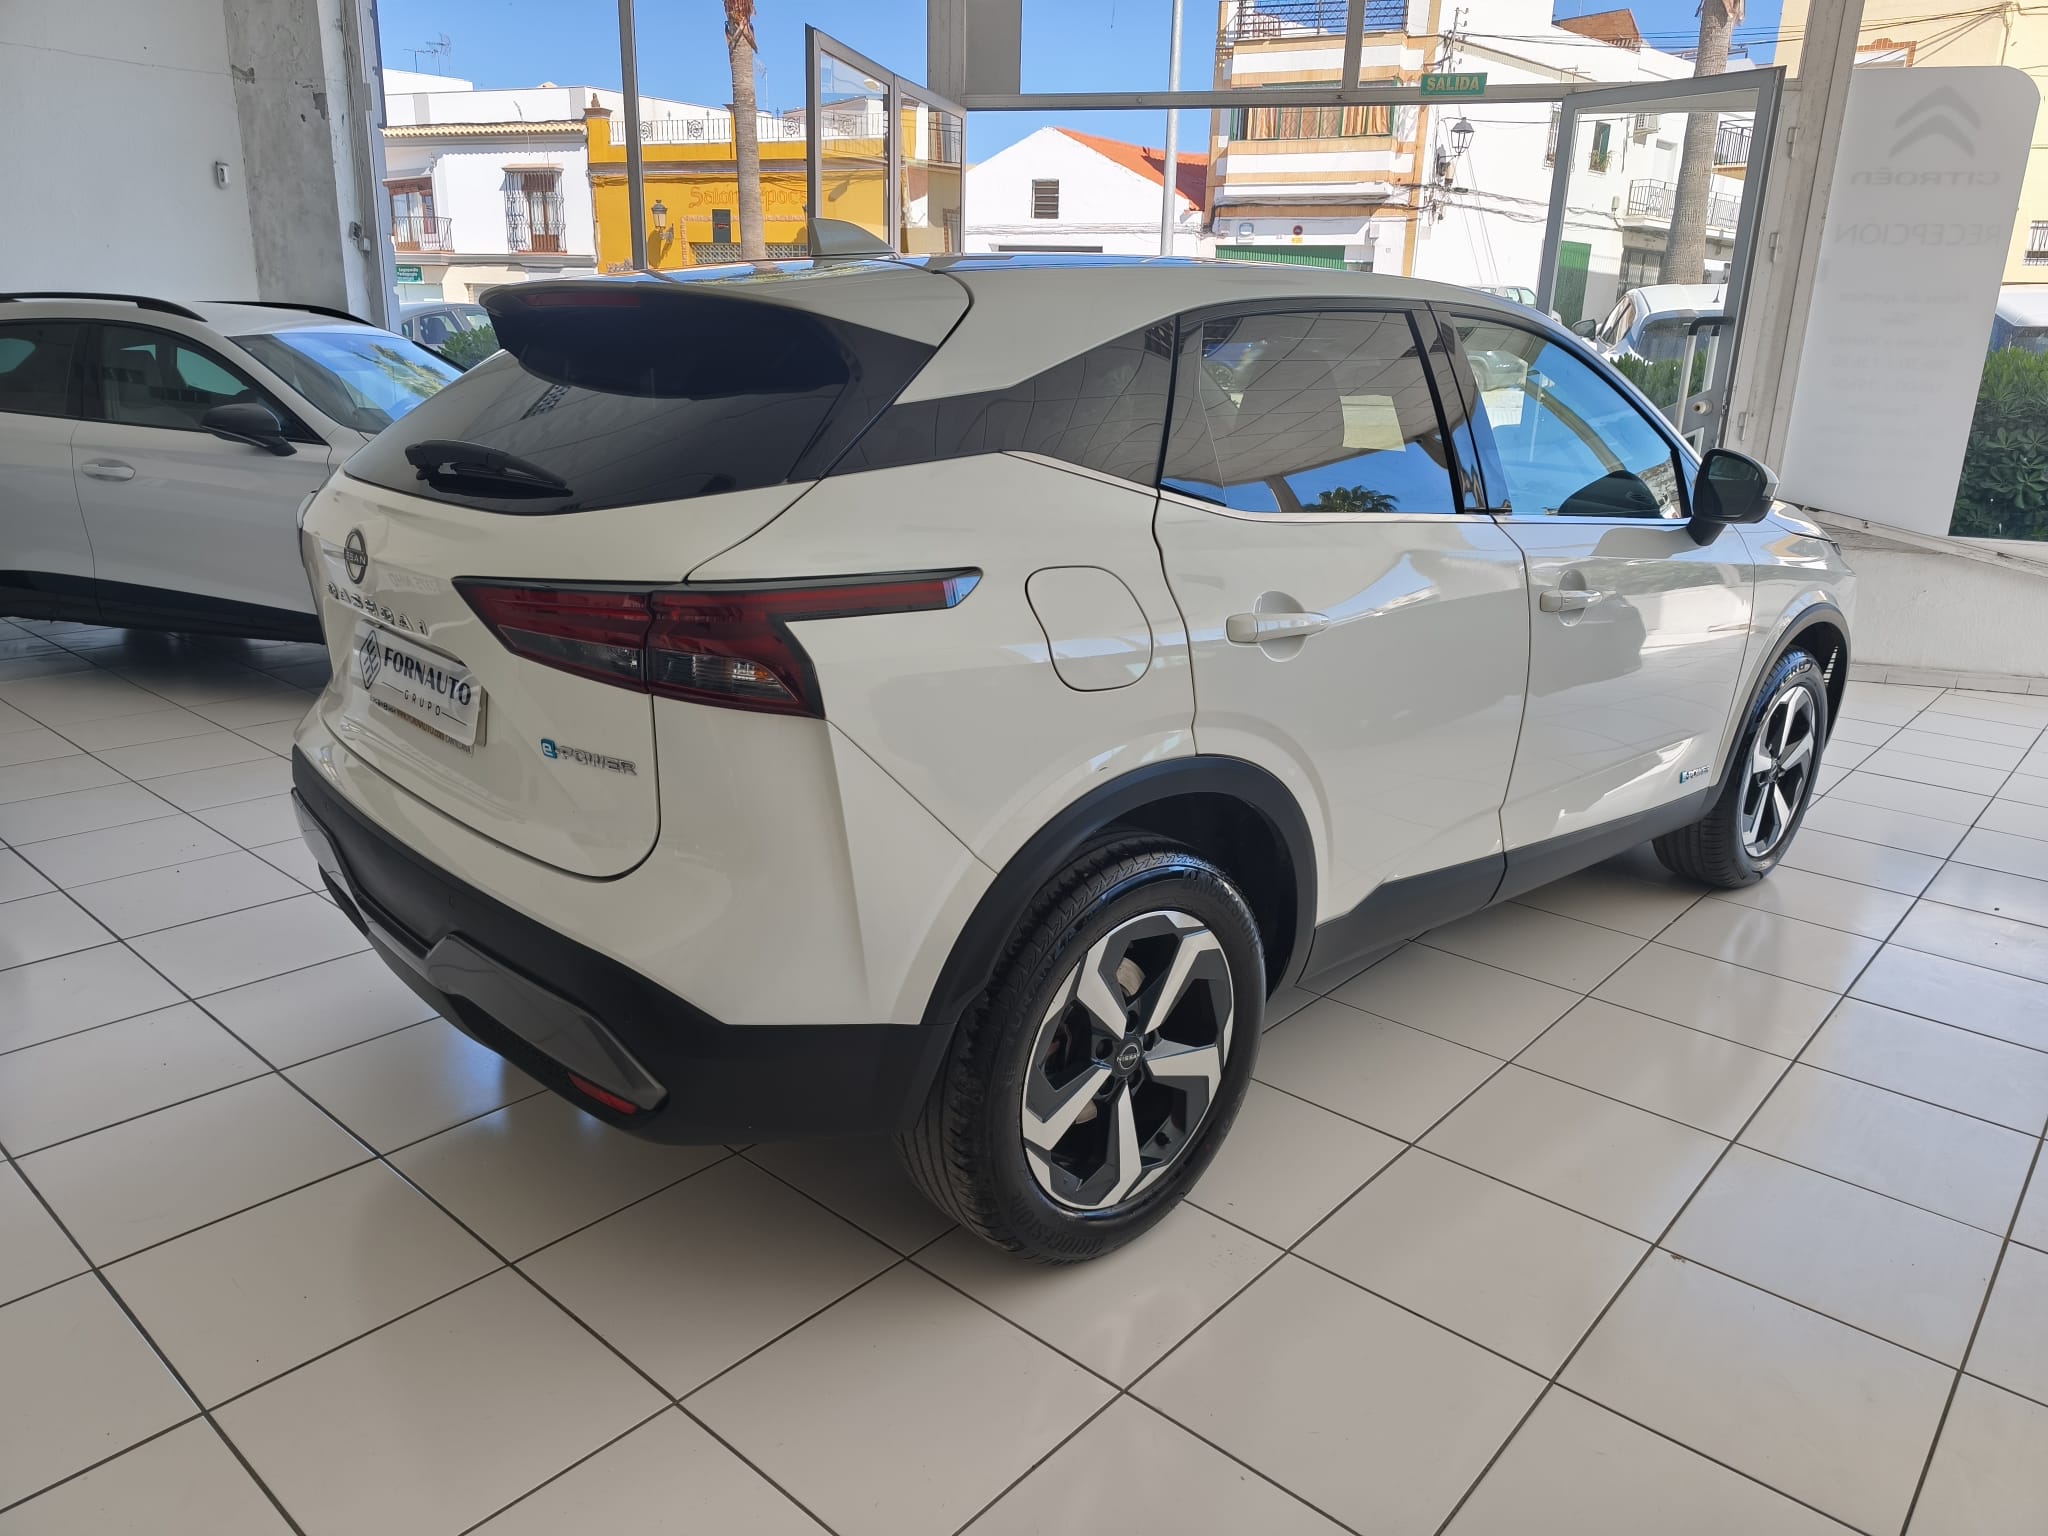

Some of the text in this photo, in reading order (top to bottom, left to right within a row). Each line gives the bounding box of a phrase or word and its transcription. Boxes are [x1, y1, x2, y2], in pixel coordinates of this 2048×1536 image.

[1427, 76, 1480, 91] SALIDA
[384, 647, 472, 706] FORNAUTO
[404, 690, 441, 716] GRUPO
